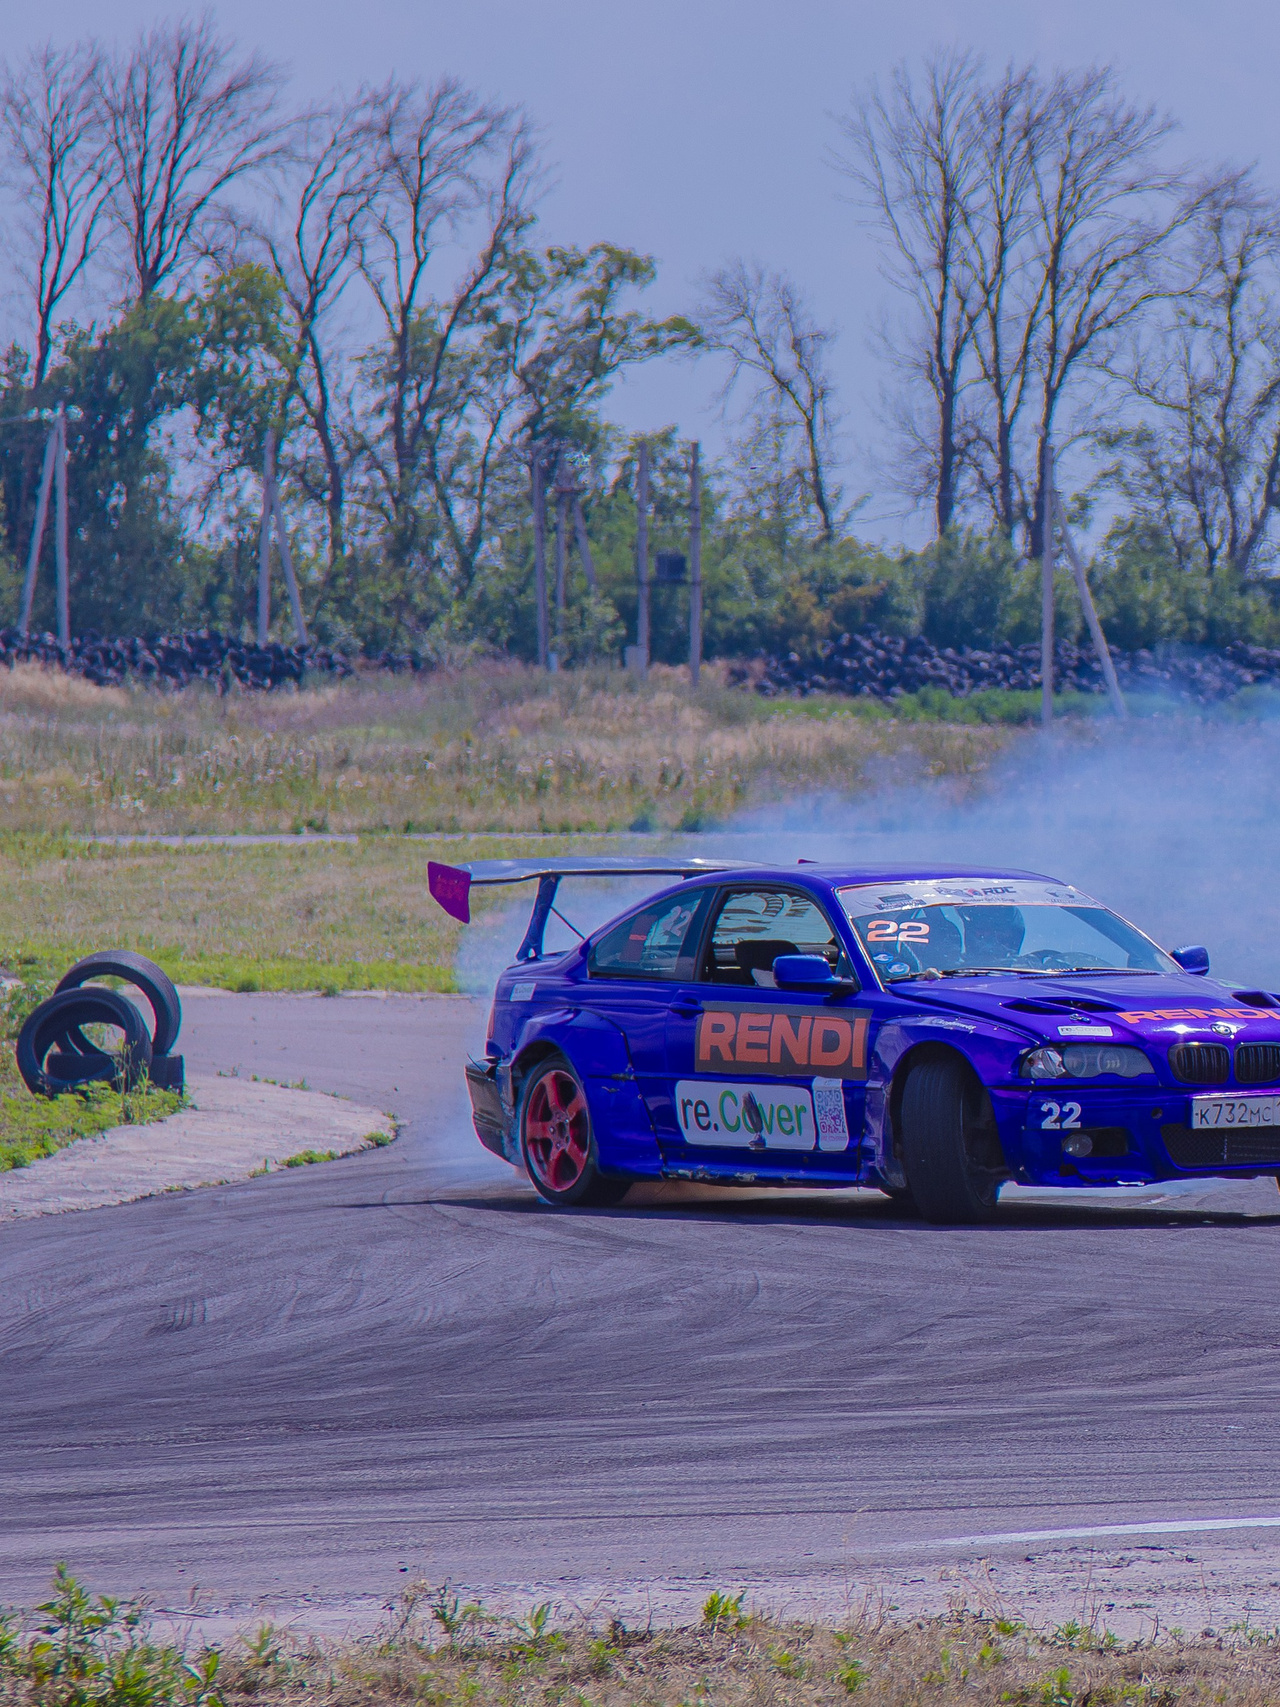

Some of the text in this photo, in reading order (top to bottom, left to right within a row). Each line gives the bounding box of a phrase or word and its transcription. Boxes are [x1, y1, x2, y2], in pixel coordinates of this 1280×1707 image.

[981, 886, 1017, 895] RDC
[867, 920, 930, 943] 22
[699, 1011, 867, 1068] RENDI
[1041, 1102, 1081, 1129] 22
